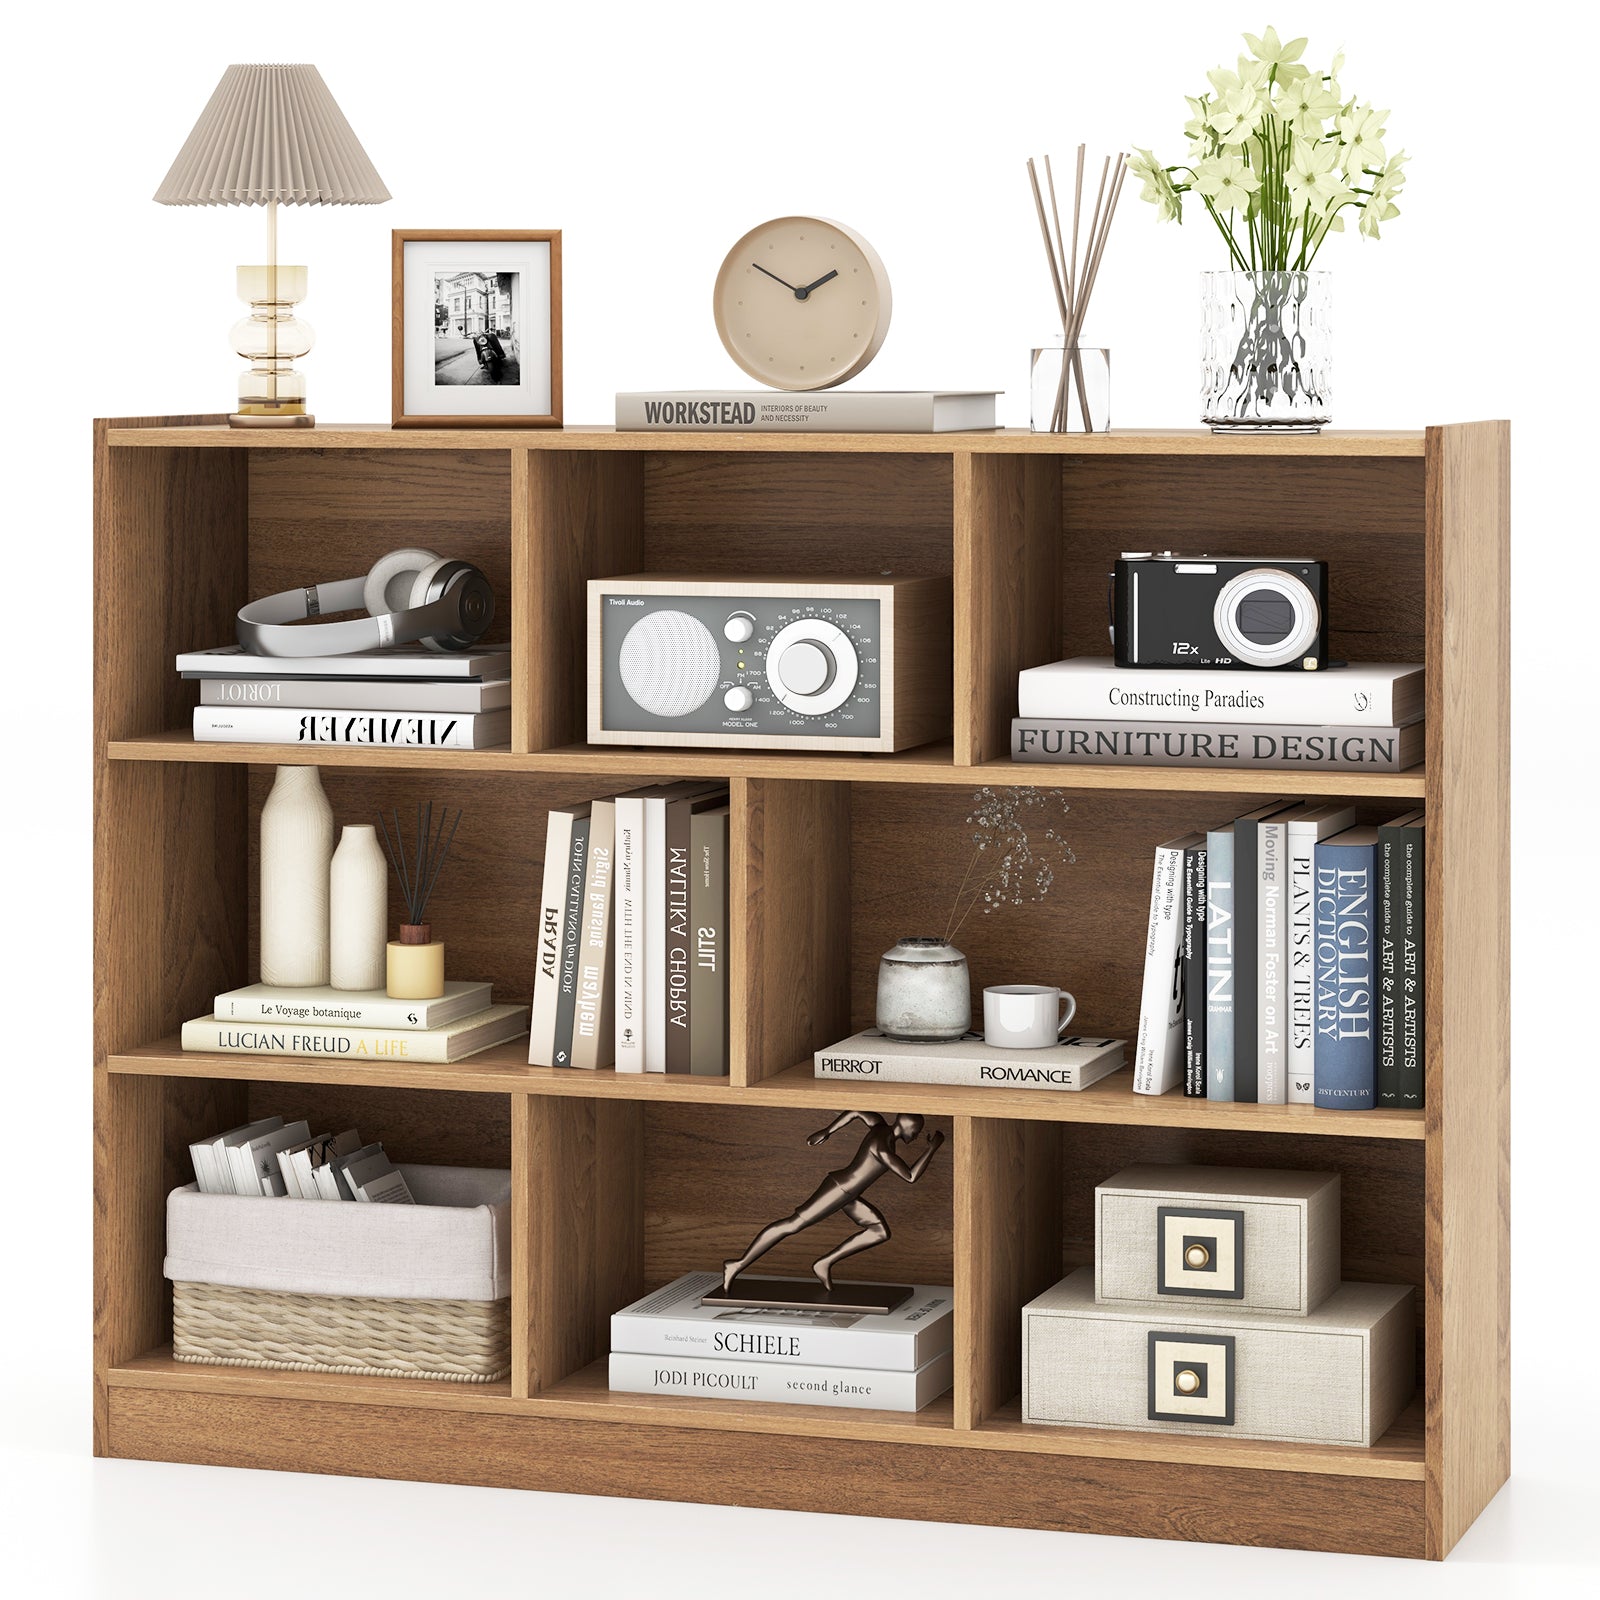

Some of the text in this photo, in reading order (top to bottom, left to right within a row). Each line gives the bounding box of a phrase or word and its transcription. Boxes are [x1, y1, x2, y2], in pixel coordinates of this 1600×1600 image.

[644, 402, 756, 424] WORKSTEAD
[1172, 642, 1199, 654] 12x
[1109, 688, 1264, 711] Constructing Paradies
[1018, 729, 1394, 763] FURNITURE DESIGN
[1166, 851, 1178, 887] Designing
[1196, 851, 1206, 887] Designing
[1153, 914, 1158, 922] to
[1164, 903, 1172, 920] type
[1196, 905, 1206, 922] type
[1382, 899, 1390, 924] guide
[1148, 922, 1158, 956] Typography
[1262, 825, 1279, 1054] Moving Norman Foster on Art
[1385, 925, 1390, 934] to
[1407, 926, 1412, 935] to
[1208, 882, 1232, 1002] LATIN
[1294, 857, 1310, 1049] PLANTS & TREES
[1318, 867, 1337, 1041] DICTIONARY
[1337, 867, 1370, 1041] ENGLISH
[1383, 937, 1394, 973] ART
[1404, 938, 1416, 975] ART
[1382, 977, 1394, 991] &
[1404, 978, 1416, 992] &
[261, 1004, 362, 1020] Le Voyage botanique
[1383, 995, 1394, 1068] ARTISTS
[1404, 995, 1416, 1068] ARTISTS
[219, 1032, 408, 1056] LUCIAN FREUD A LIFE
[821, 1058, 882, 1074] PIERROT
[980, 1067, 1072, 1084] ROMANCE
[713, 1332, 801, 1356] SCHIELE
[654, 1370, 758, 1390] JODI PICOULT
[787, 1380, 872, 1396] second glance
